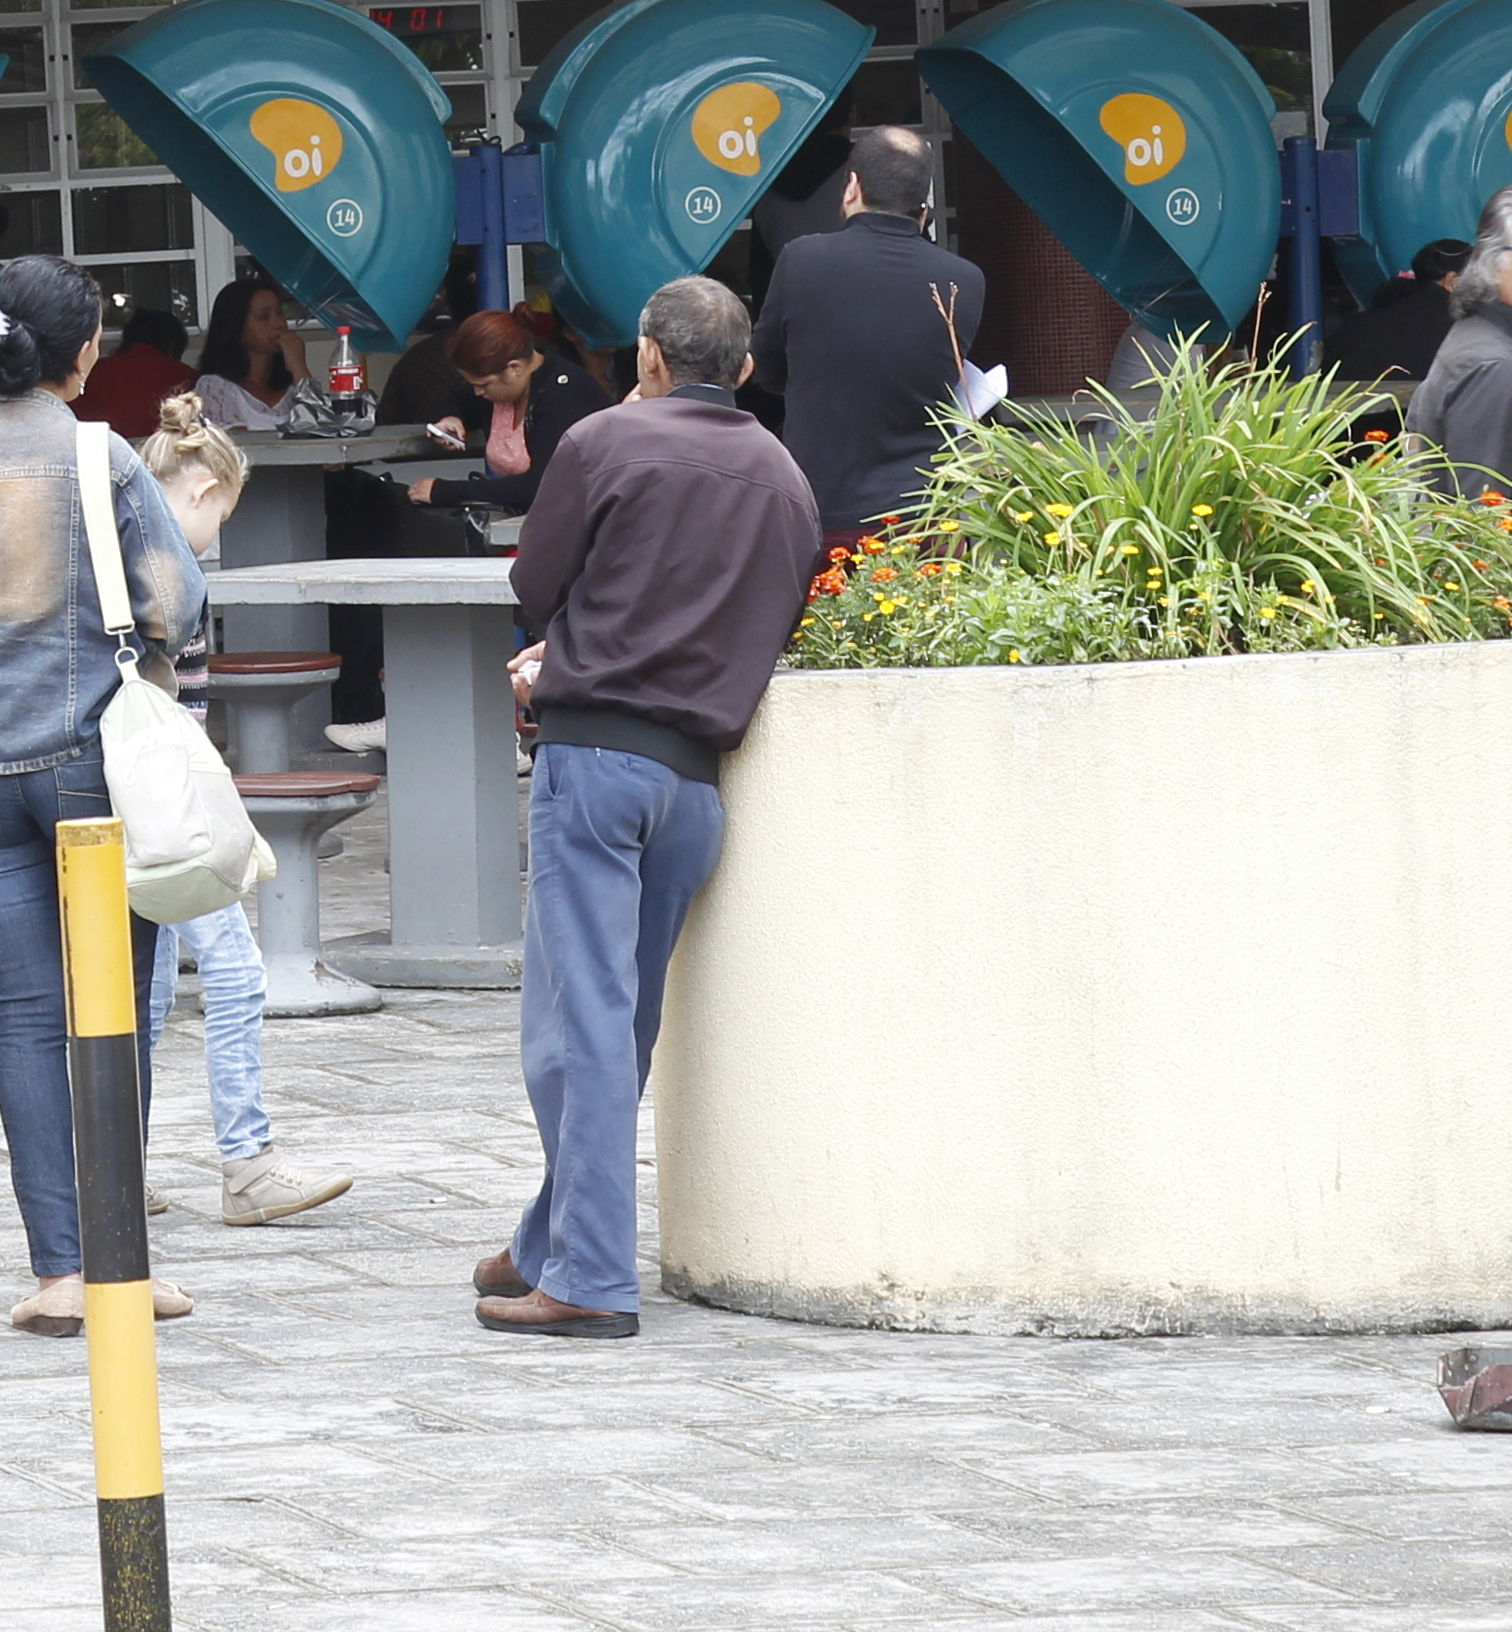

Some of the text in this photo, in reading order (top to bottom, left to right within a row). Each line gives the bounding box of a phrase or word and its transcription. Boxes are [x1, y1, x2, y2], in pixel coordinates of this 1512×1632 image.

[410, 8, 445, 30] 01
[717, 116, 757, 160] oi
[1128, 124, 1164, 167] oi
[283, 134, 323, 179] oi
[692, 196, 714, 215] 14
[1173, 197, 1193, 216] 14
[334, 208, 356, 227] 14
